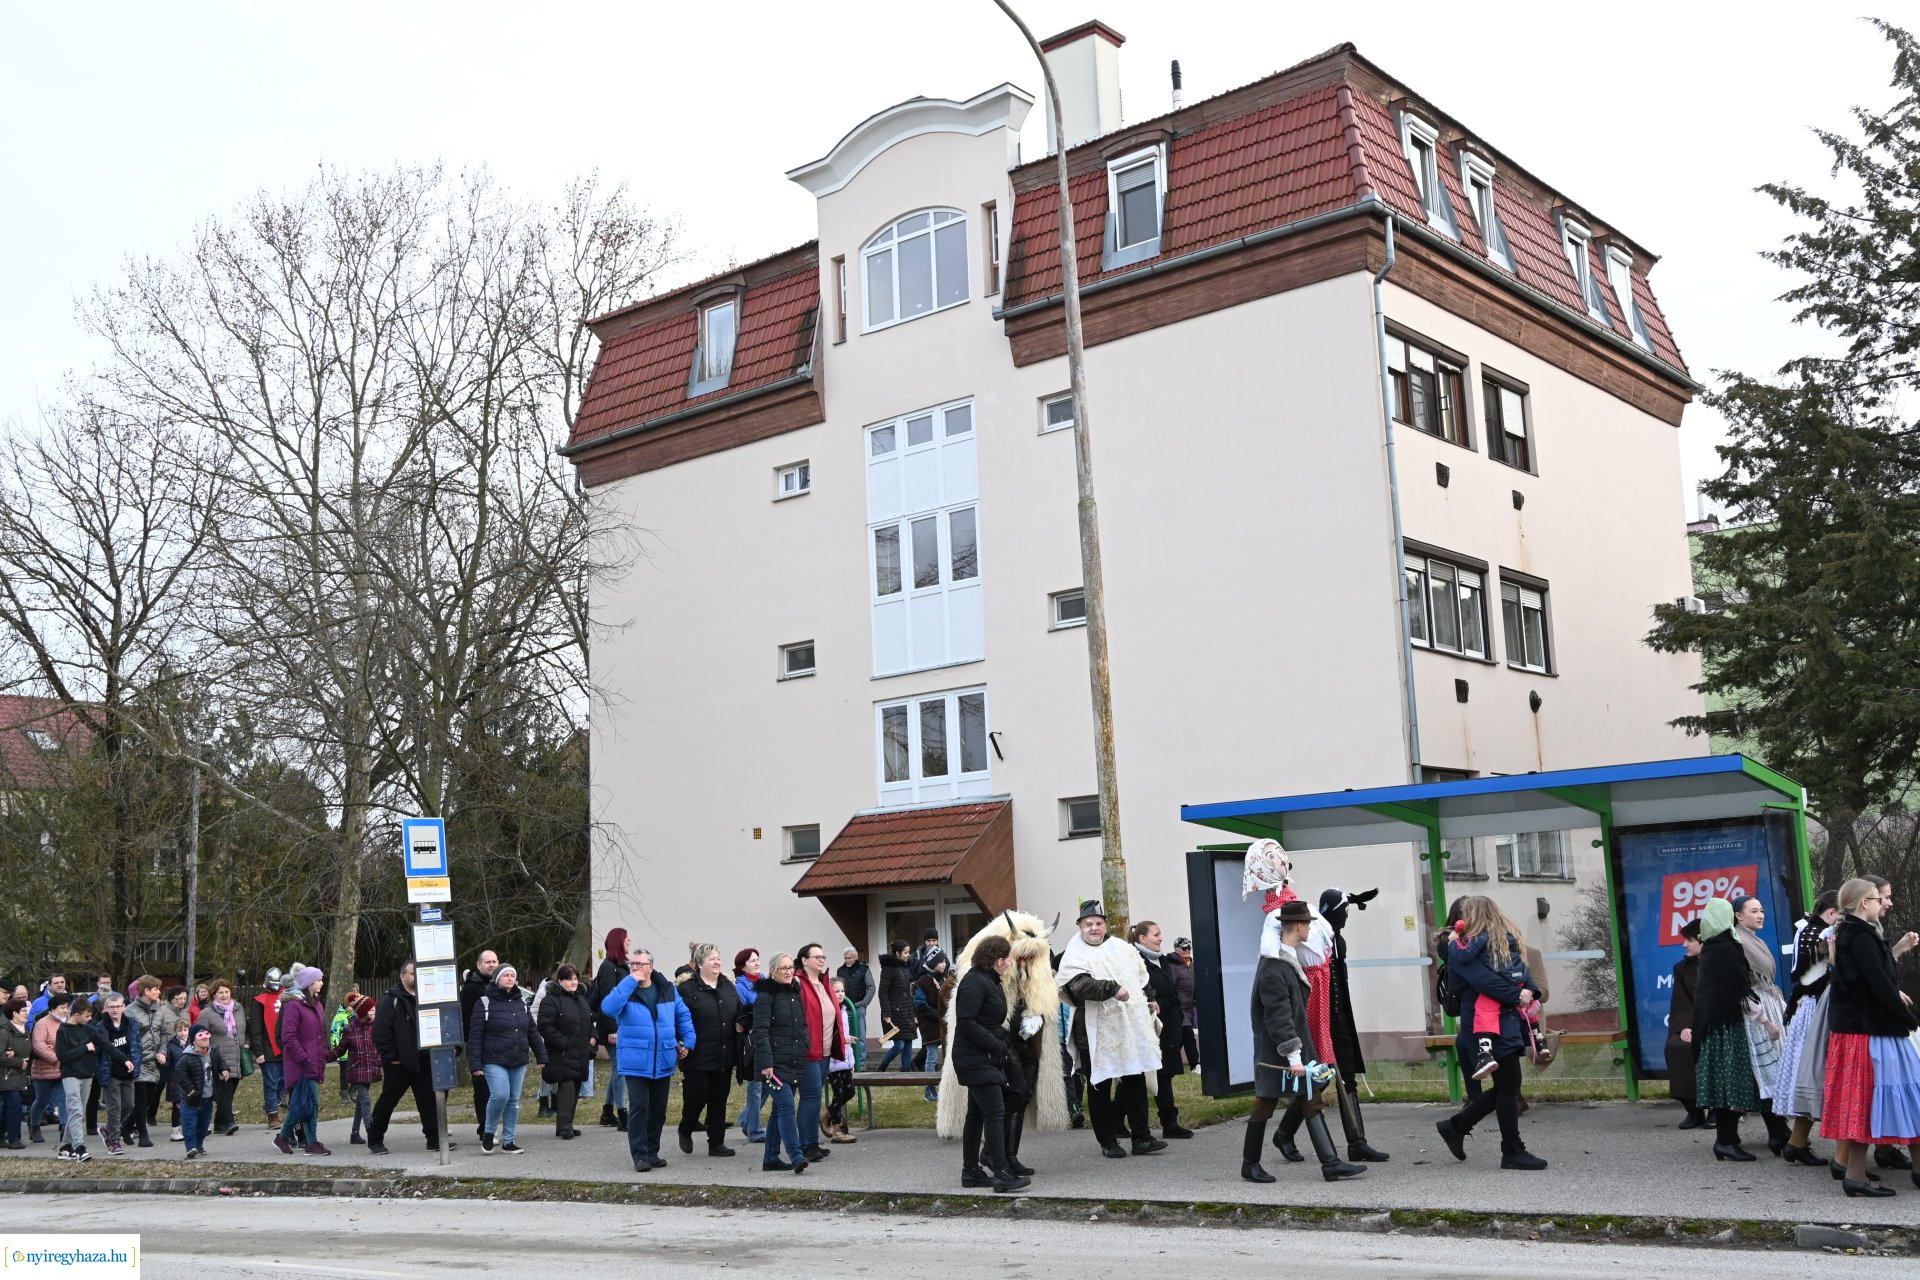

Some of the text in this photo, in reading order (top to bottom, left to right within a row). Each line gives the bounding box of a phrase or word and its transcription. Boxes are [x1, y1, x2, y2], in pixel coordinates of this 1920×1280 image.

[1673, 875, 1746, 908] 99%
[1671, 909, 1705, 937] N
[1657, 974, 1675, 990] M
